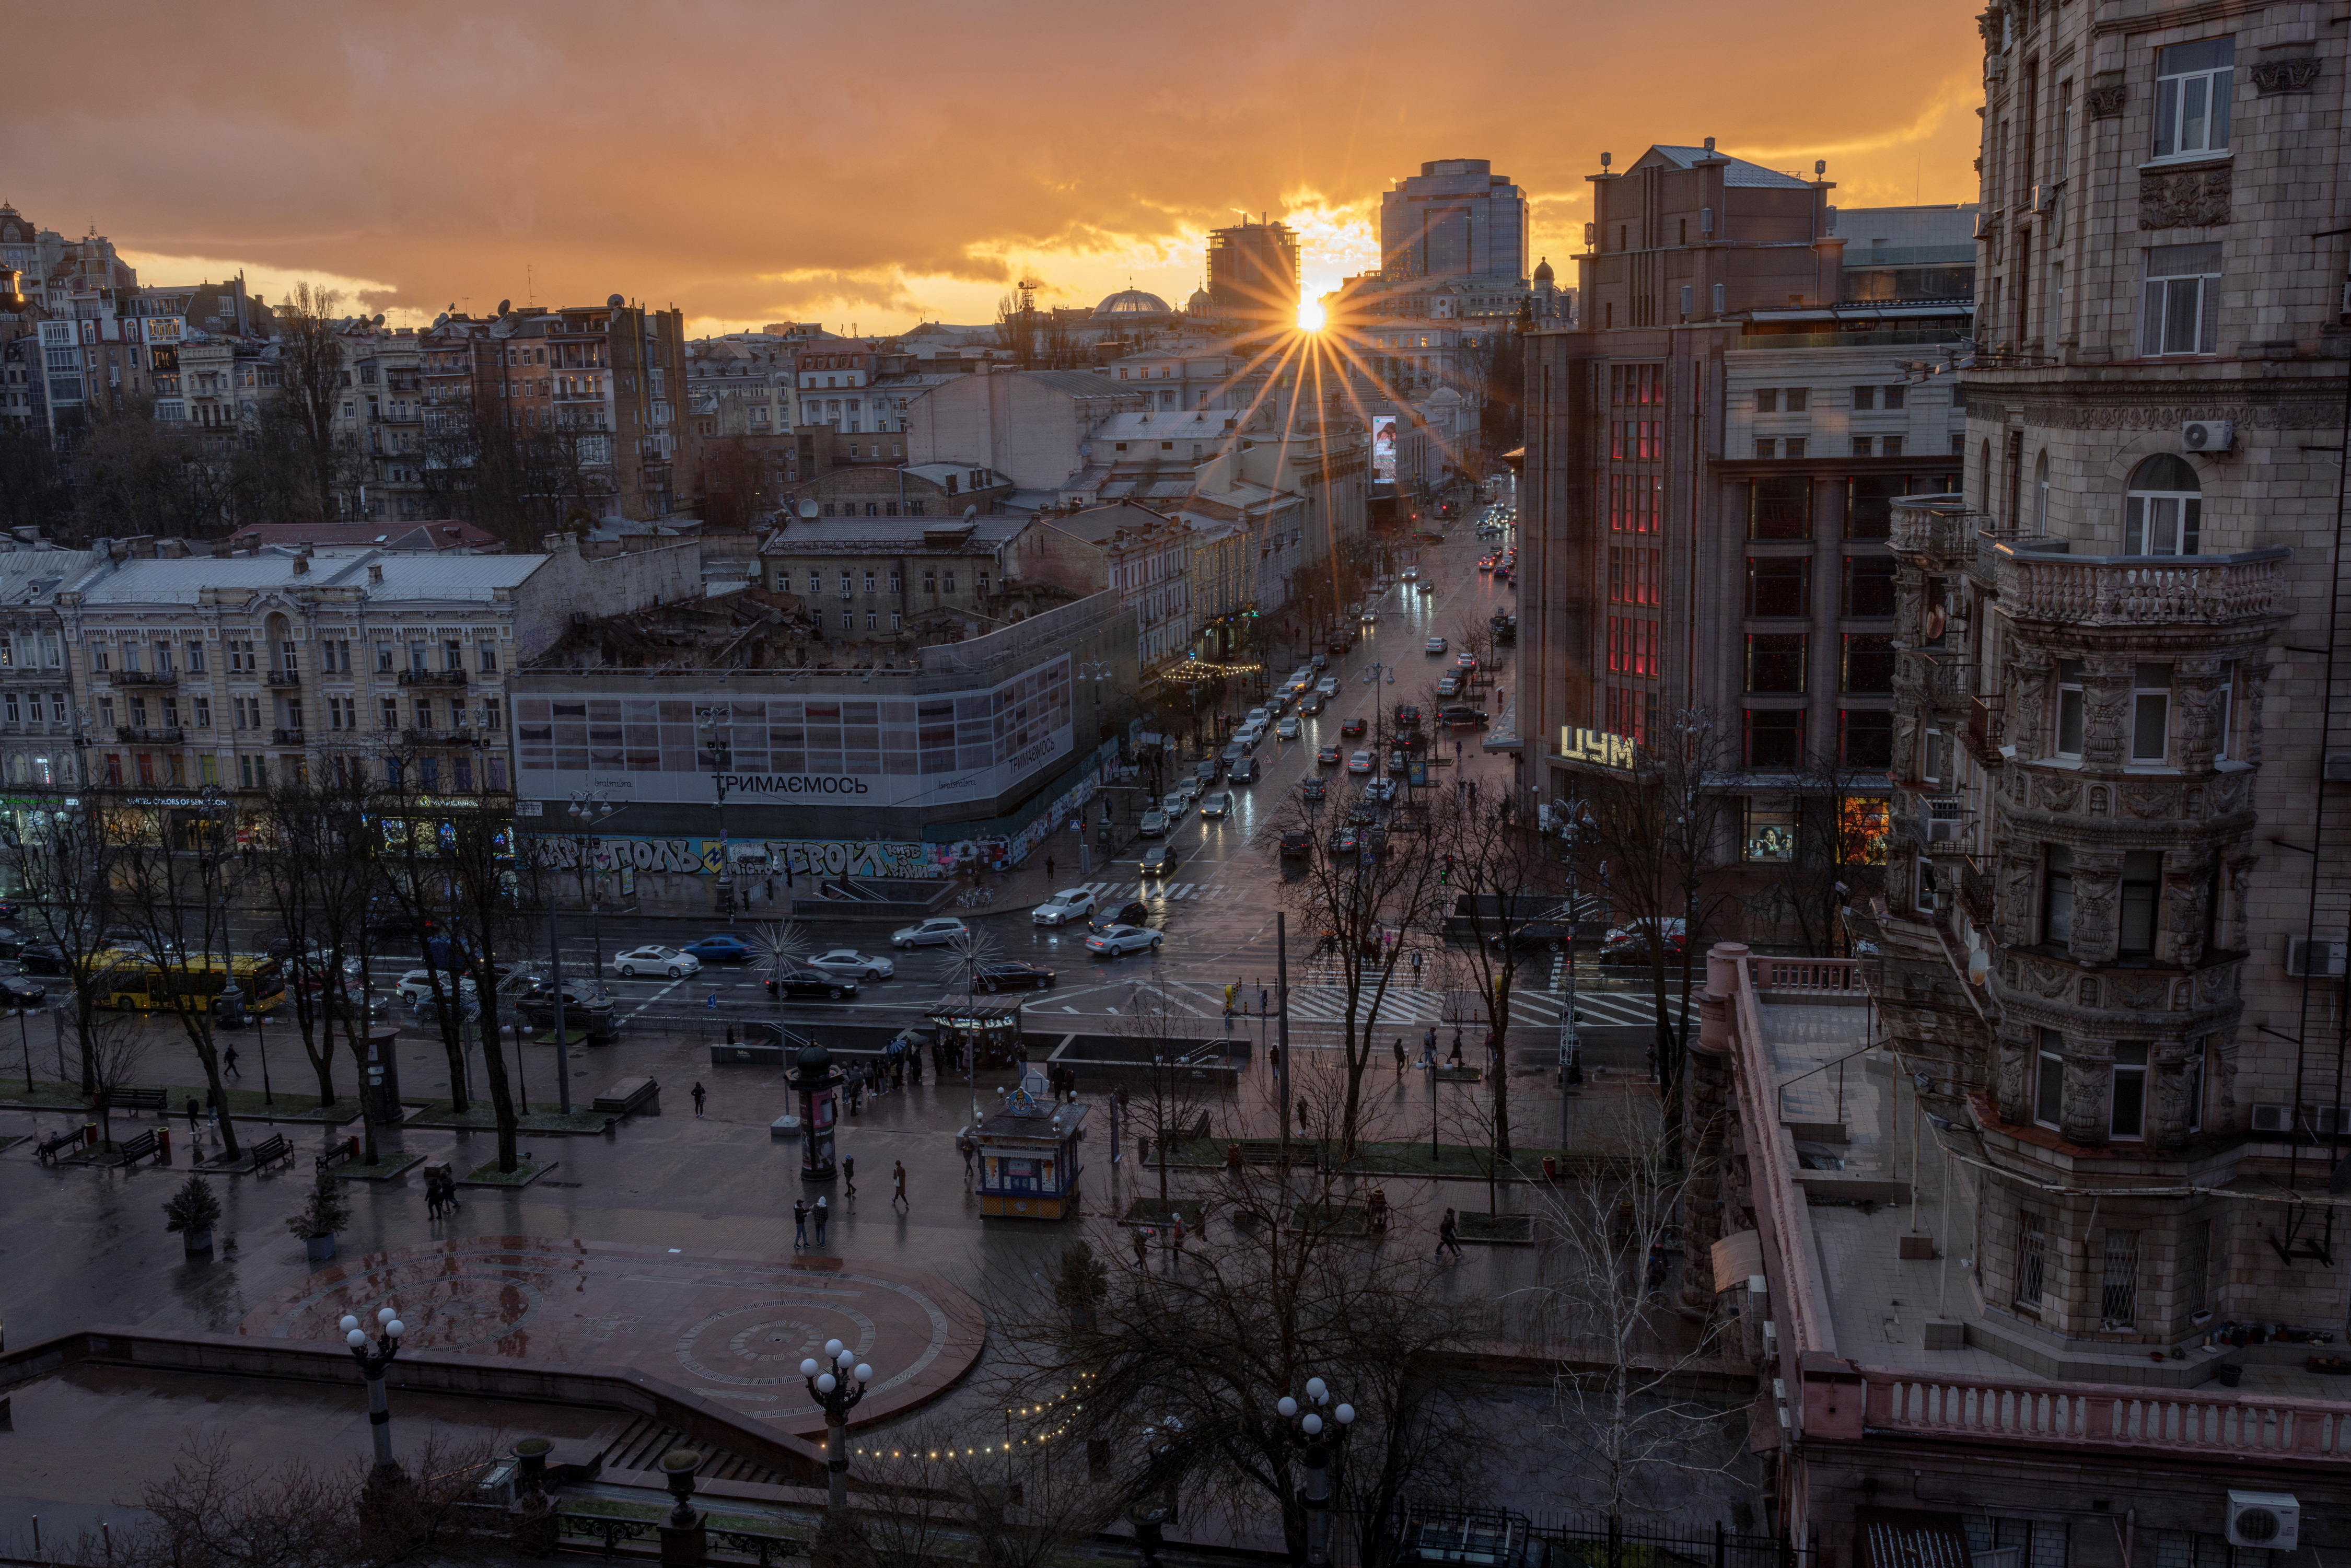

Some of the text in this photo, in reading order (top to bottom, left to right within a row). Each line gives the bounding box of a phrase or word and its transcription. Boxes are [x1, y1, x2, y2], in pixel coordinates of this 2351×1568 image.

[1562, 725, 1635, 769] ЦУМ
[1009, 737, 1055, 775] ТРИМАЄМОСЬ
[595, 777, 633, 787] brabrabra
[712, 775, 868, 794] ТРИМАЄМОСЬ
[938, 780, 976, 789] brabrabra
[1018, 1099, 1034, 1109] King
